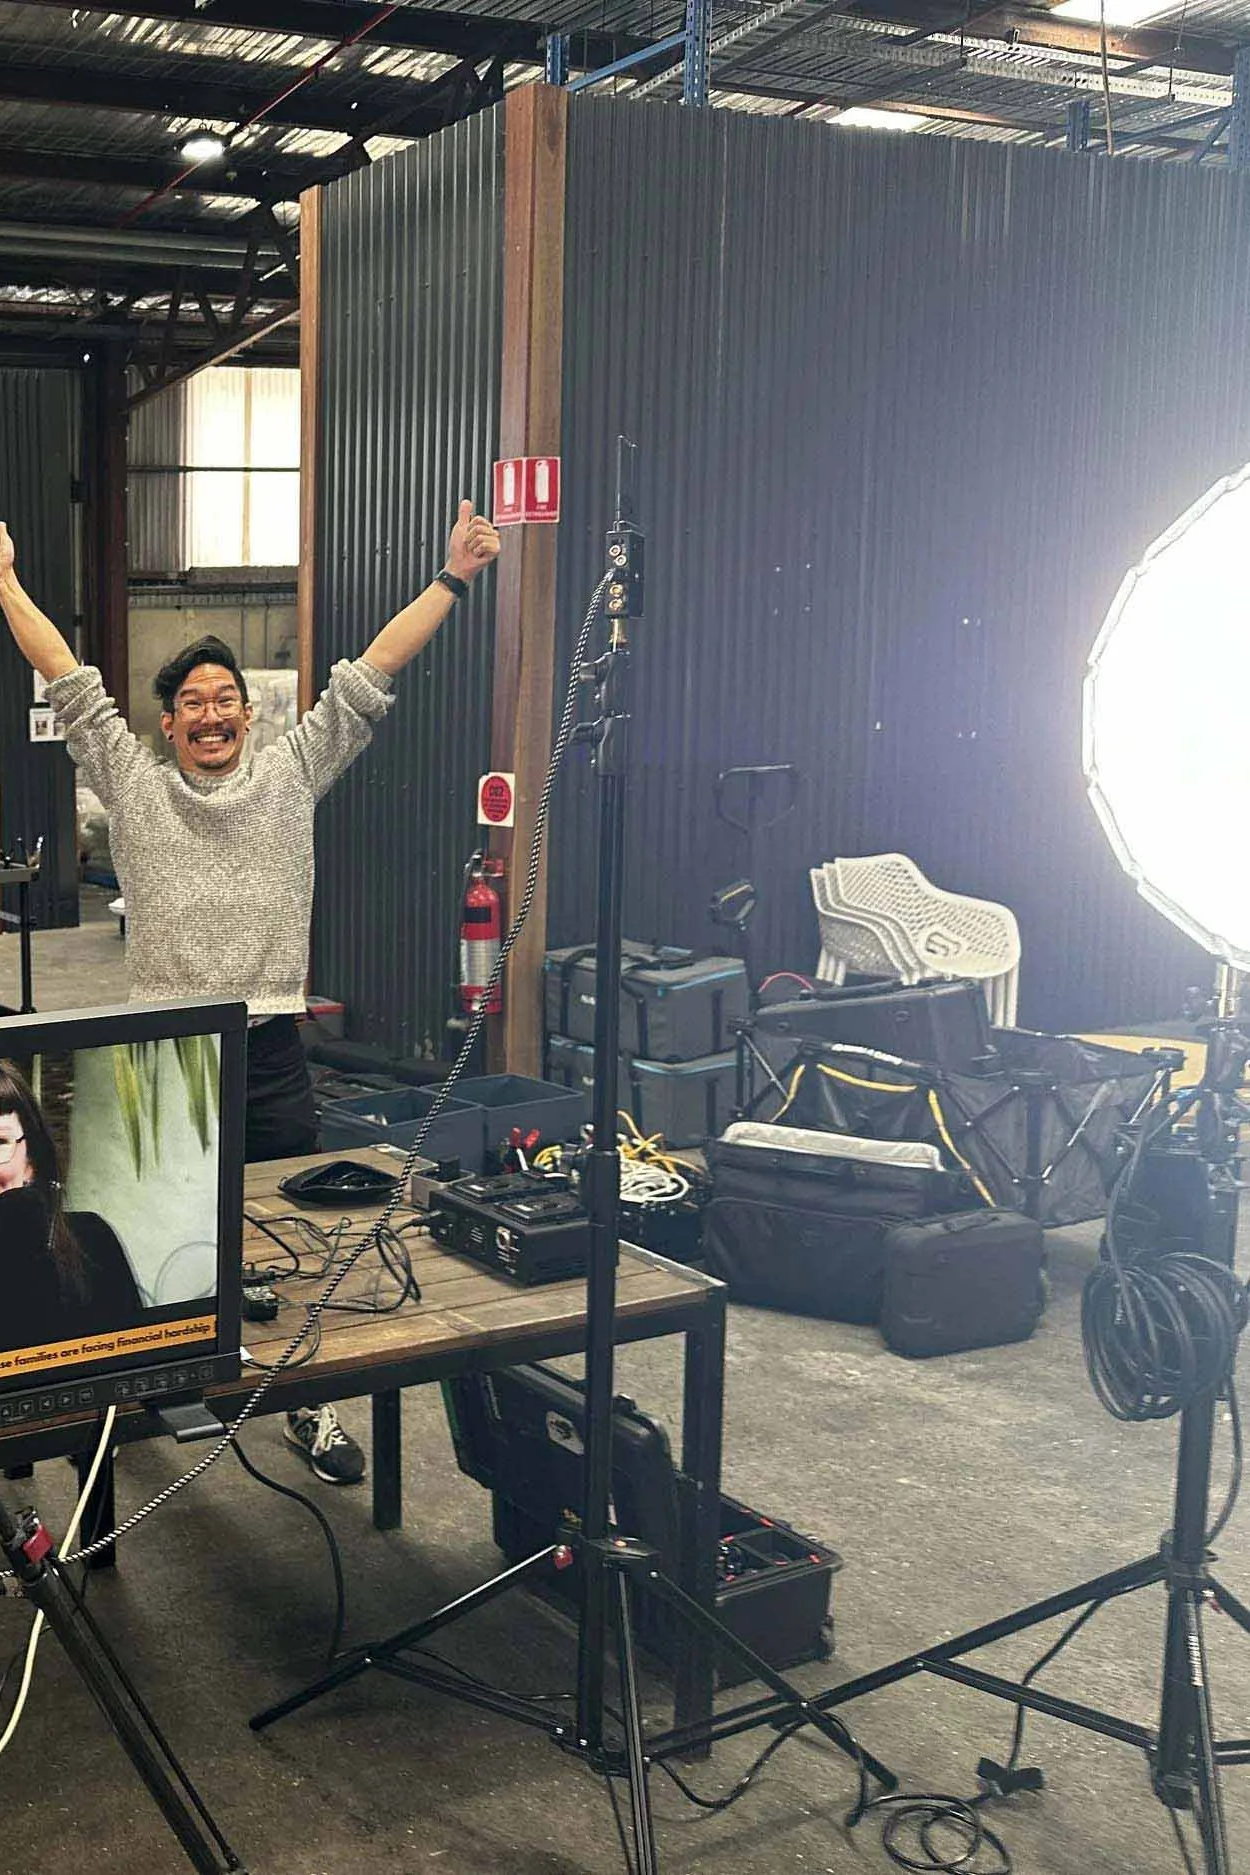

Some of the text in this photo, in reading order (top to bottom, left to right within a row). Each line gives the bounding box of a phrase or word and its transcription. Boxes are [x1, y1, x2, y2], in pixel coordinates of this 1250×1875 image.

[14, 1351, 59, 1367] families
[60, 1347, 80, 1358] are
[81, 1340, 115, 1356] facing
[117, 1330, 163, 1348] financial
[164, 1322, 211, 1339] hardship
